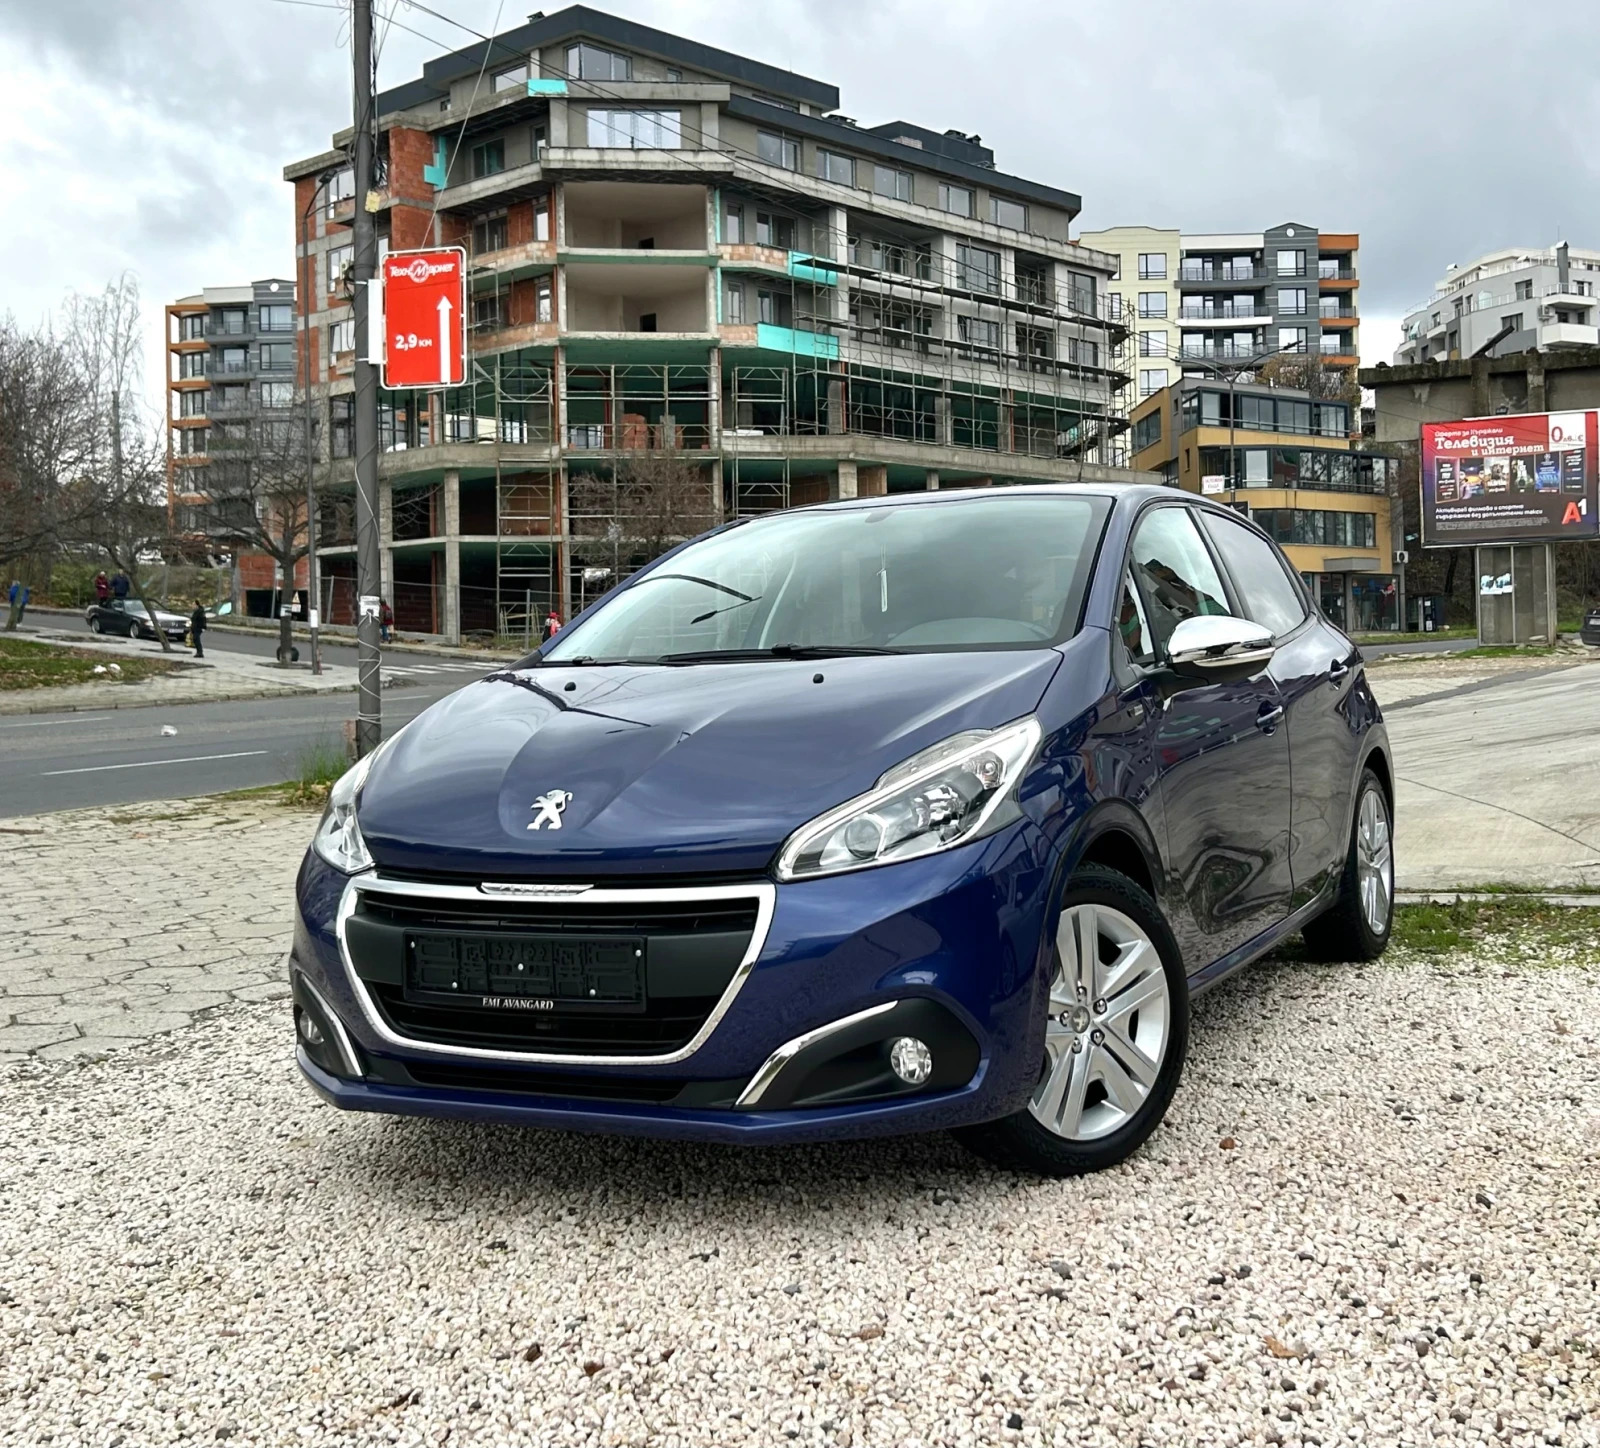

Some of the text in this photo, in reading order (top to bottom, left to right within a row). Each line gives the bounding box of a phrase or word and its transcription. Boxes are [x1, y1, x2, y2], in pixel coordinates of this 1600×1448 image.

[395, 333, 418, 351] 2,9
[1435, 435, 1514, 450] Телевизия
[1471, 448, 1478, 456] и
[1481, 444, 1544, 456] интернет
[1561, 498, 1587, 525] A1
[482, 997, 554, 1010] EMI AVANGARD
